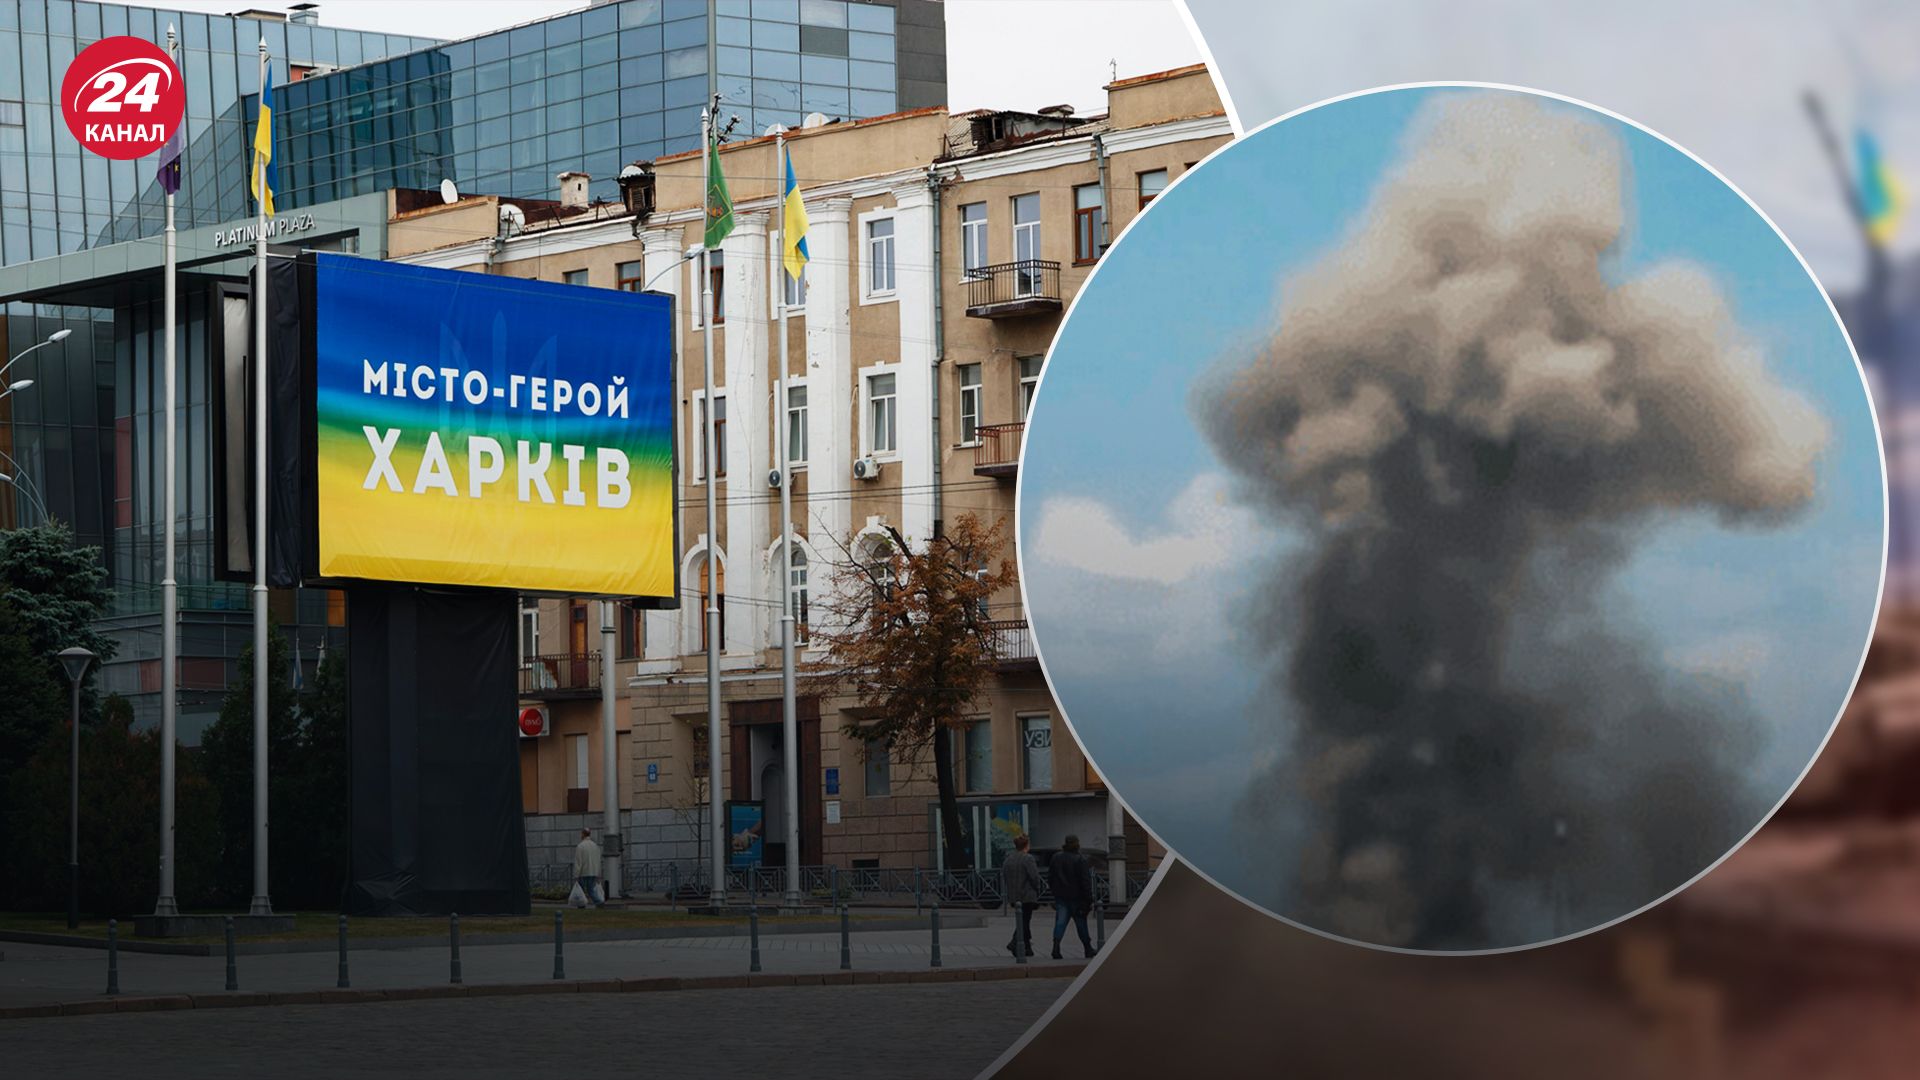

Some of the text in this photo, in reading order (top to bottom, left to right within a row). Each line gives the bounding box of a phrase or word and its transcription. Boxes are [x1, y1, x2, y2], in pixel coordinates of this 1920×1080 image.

[279, 213, 314, 235] PLAZA
[363, 358, 629, 419] МІСТО-ГЕРОЙ
[362, 425, 632, 509] ХАРКІВ
